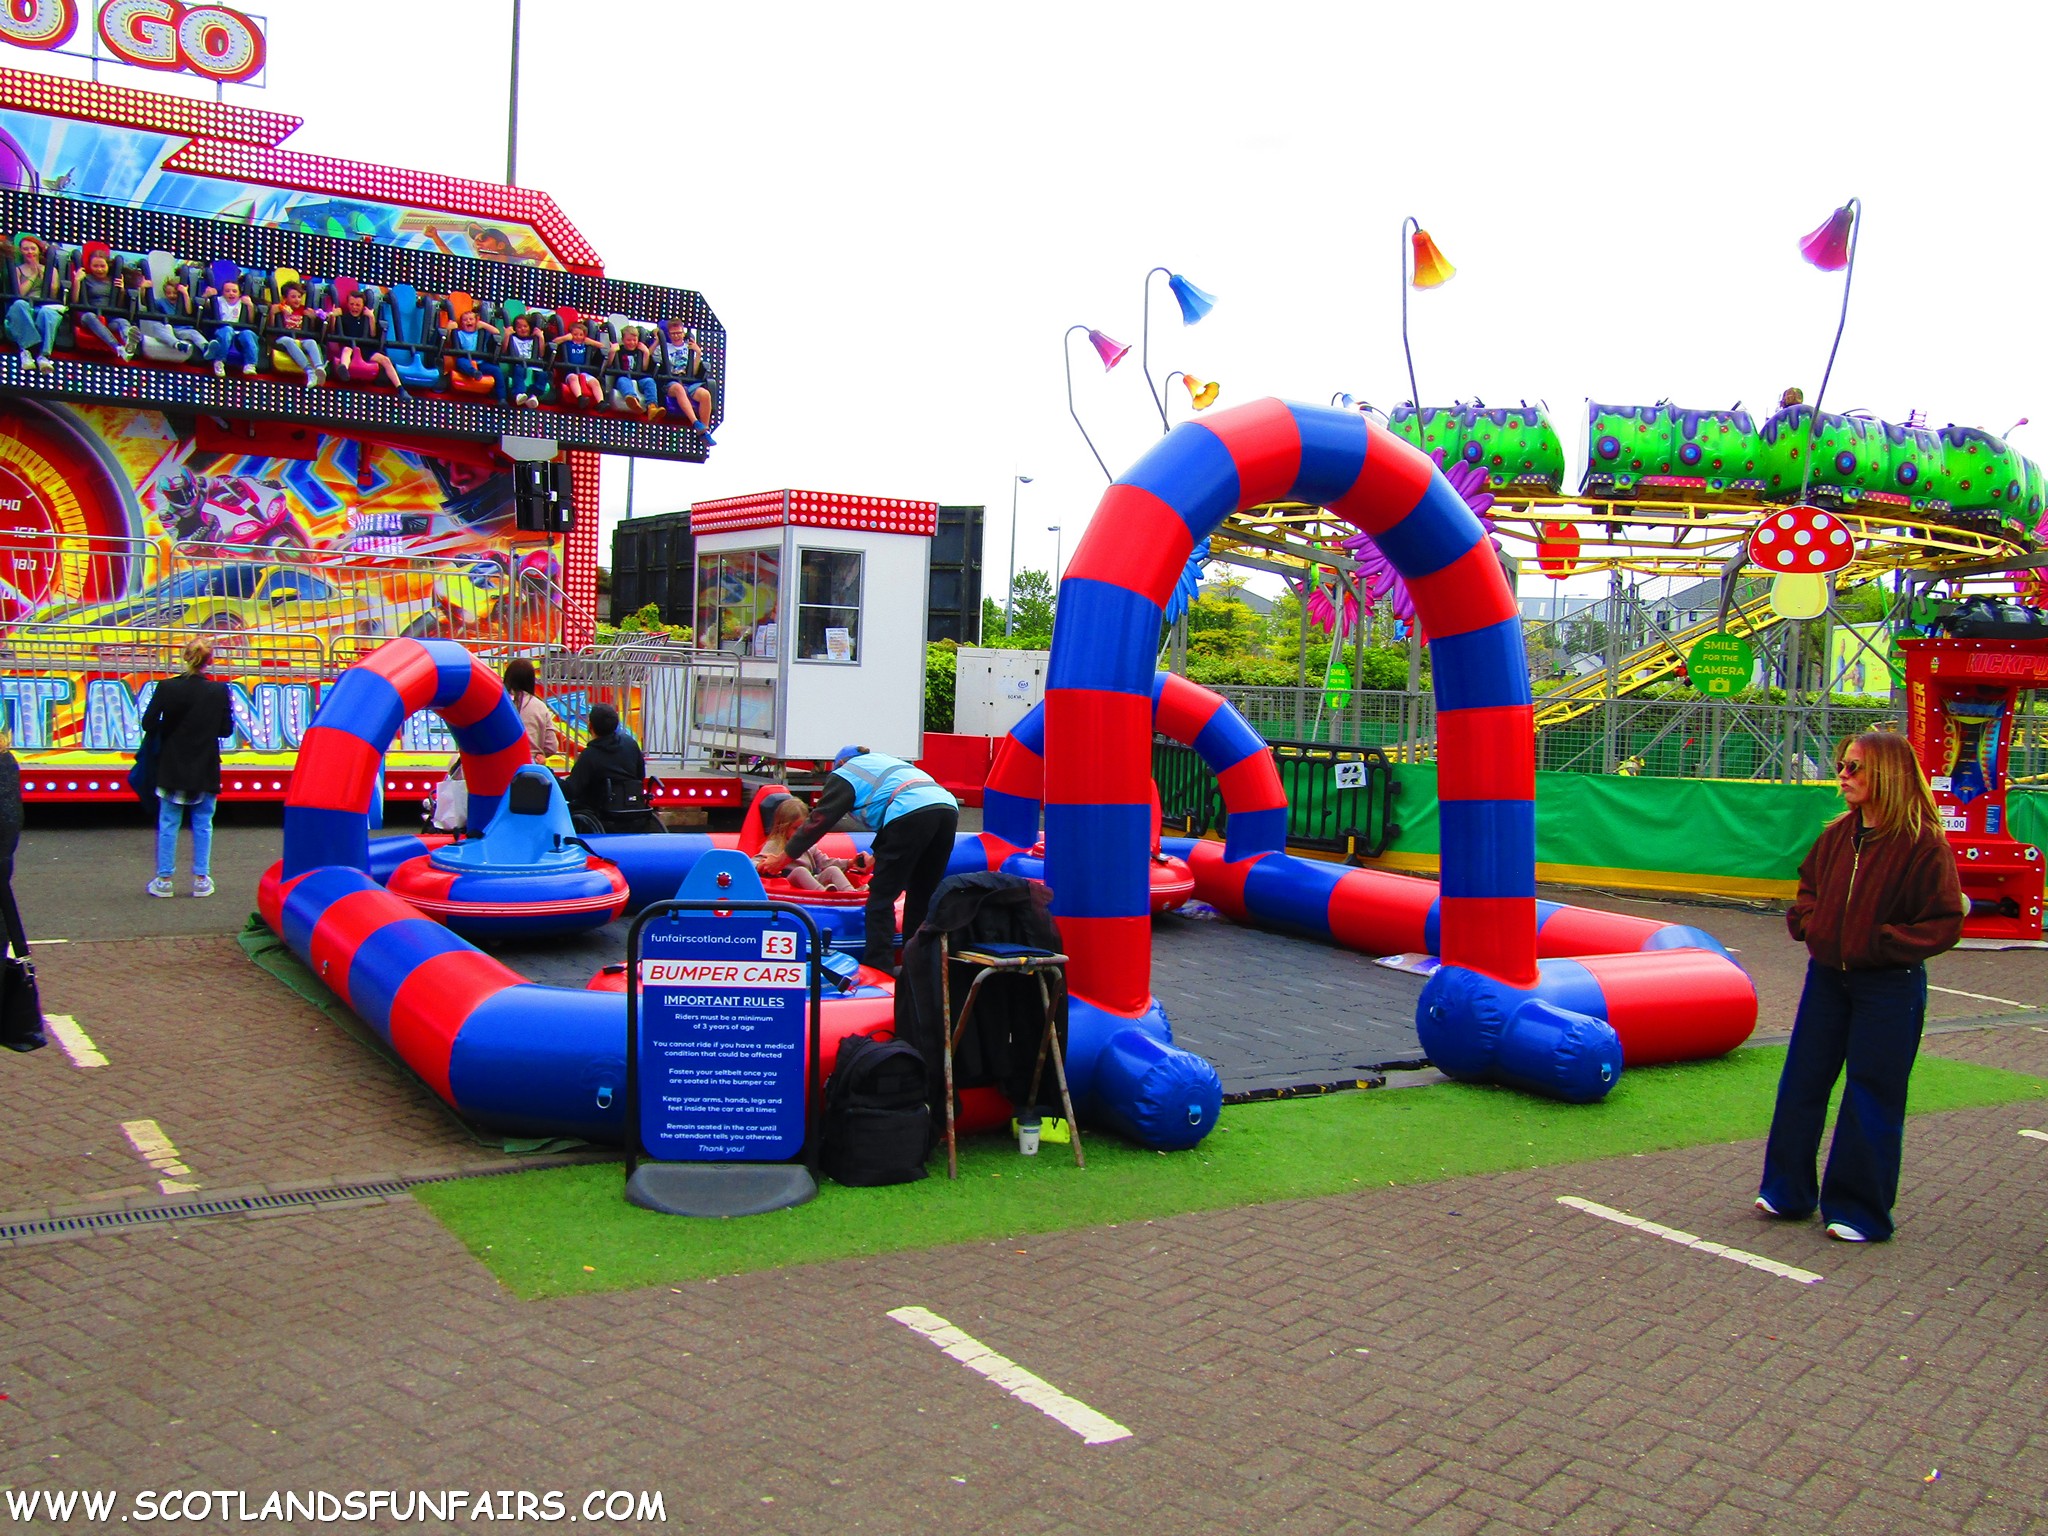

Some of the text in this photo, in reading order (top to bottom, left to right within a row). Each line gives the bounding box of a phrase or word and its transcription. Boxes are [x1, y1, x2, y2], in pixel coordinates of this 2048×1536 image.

[103, 0, 256, 76] GO
[1703, 640, 1739, 651] SMILE
[1694, 665, 1745, 676] CAMERA
[651, 934, 757, 945] funfairscotland.com
[766, 936, 793, 955] £3
[650, 965, 801, 983] BUMPER CARS
[664, 995, 784, 1008] IMPORTANT RULES
[674, 1013, 699, 1021] Riders
[732, 1079, 762, 1087] bumper
[662, 1095, 682, 1103] Keep
[724, 1097, 750, 1105] hands,
[750, 1097, 766, 1105] legs
[699, 1144, 745, 1153] Thank you!
